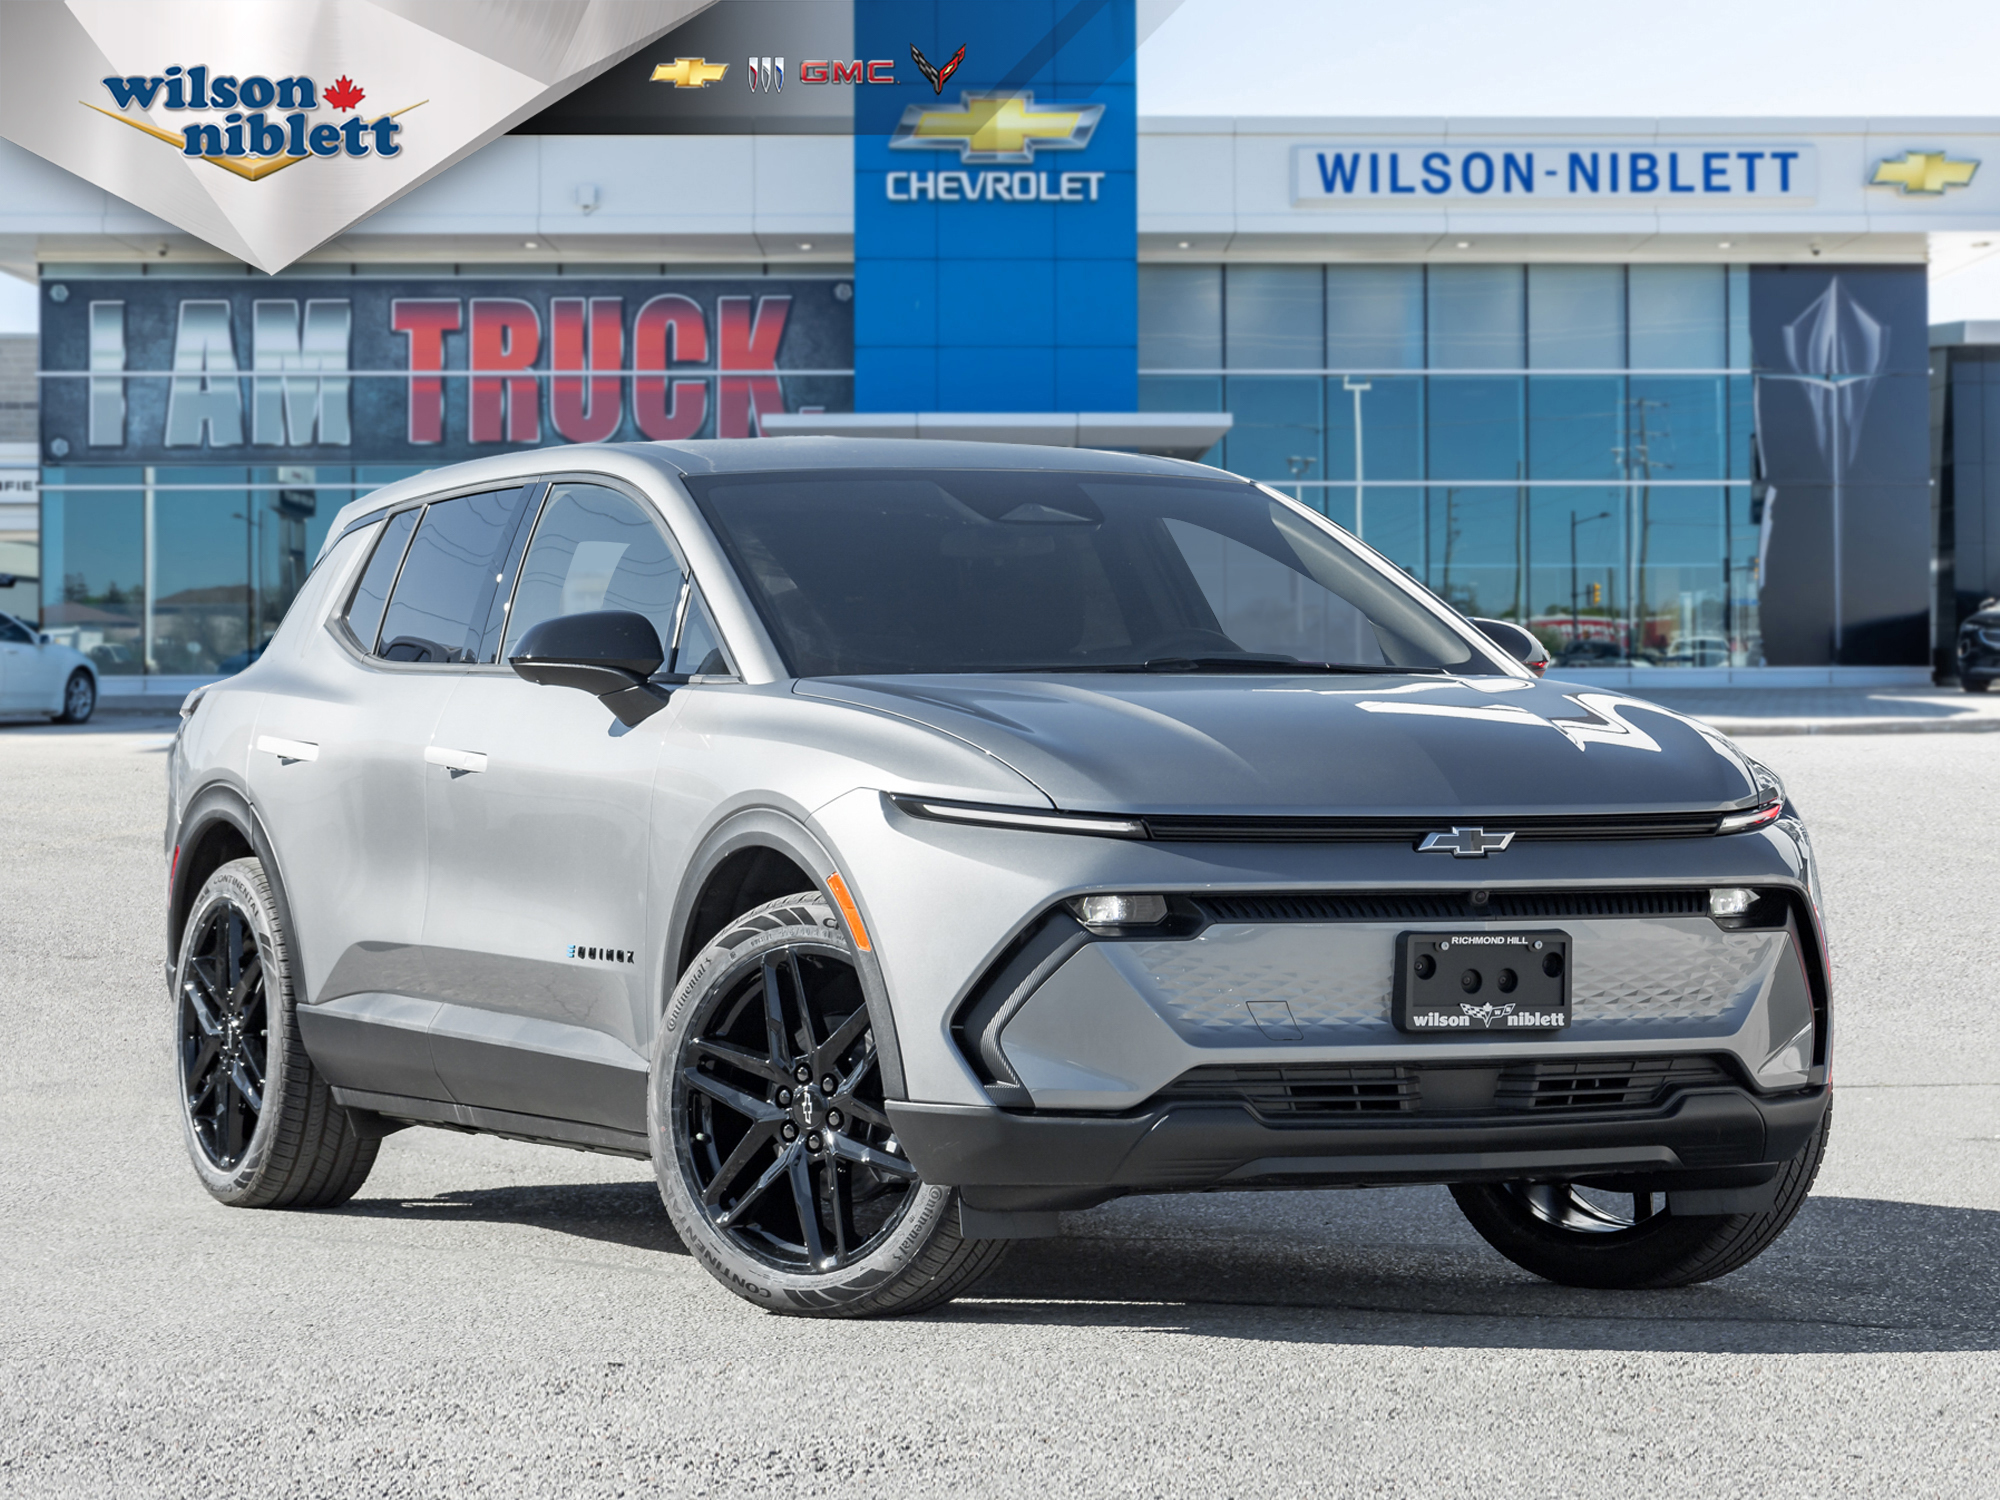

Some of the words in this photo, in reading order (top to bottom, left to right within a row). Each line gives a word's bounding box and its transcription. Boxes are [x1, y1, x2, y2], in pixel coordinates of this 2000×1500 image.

[1316, 151, 1800, 194] WILSON-NIBLETT
[885, 171, 1105, 201] CHEVROLET
[88, 299, 126, 447] I
[164, 299, 352, 447] AM
[390, 293, 826, 444] TRUCK
[1451, 936, 1505, 945] RICHMOND
[1507, 936, 1529, 945] HILL
[566, 944, 635, 964] EQUINOX
[1413, 1012, 1471, 1027] wilson
[1507, 1012, 1565, 1026] niblett
